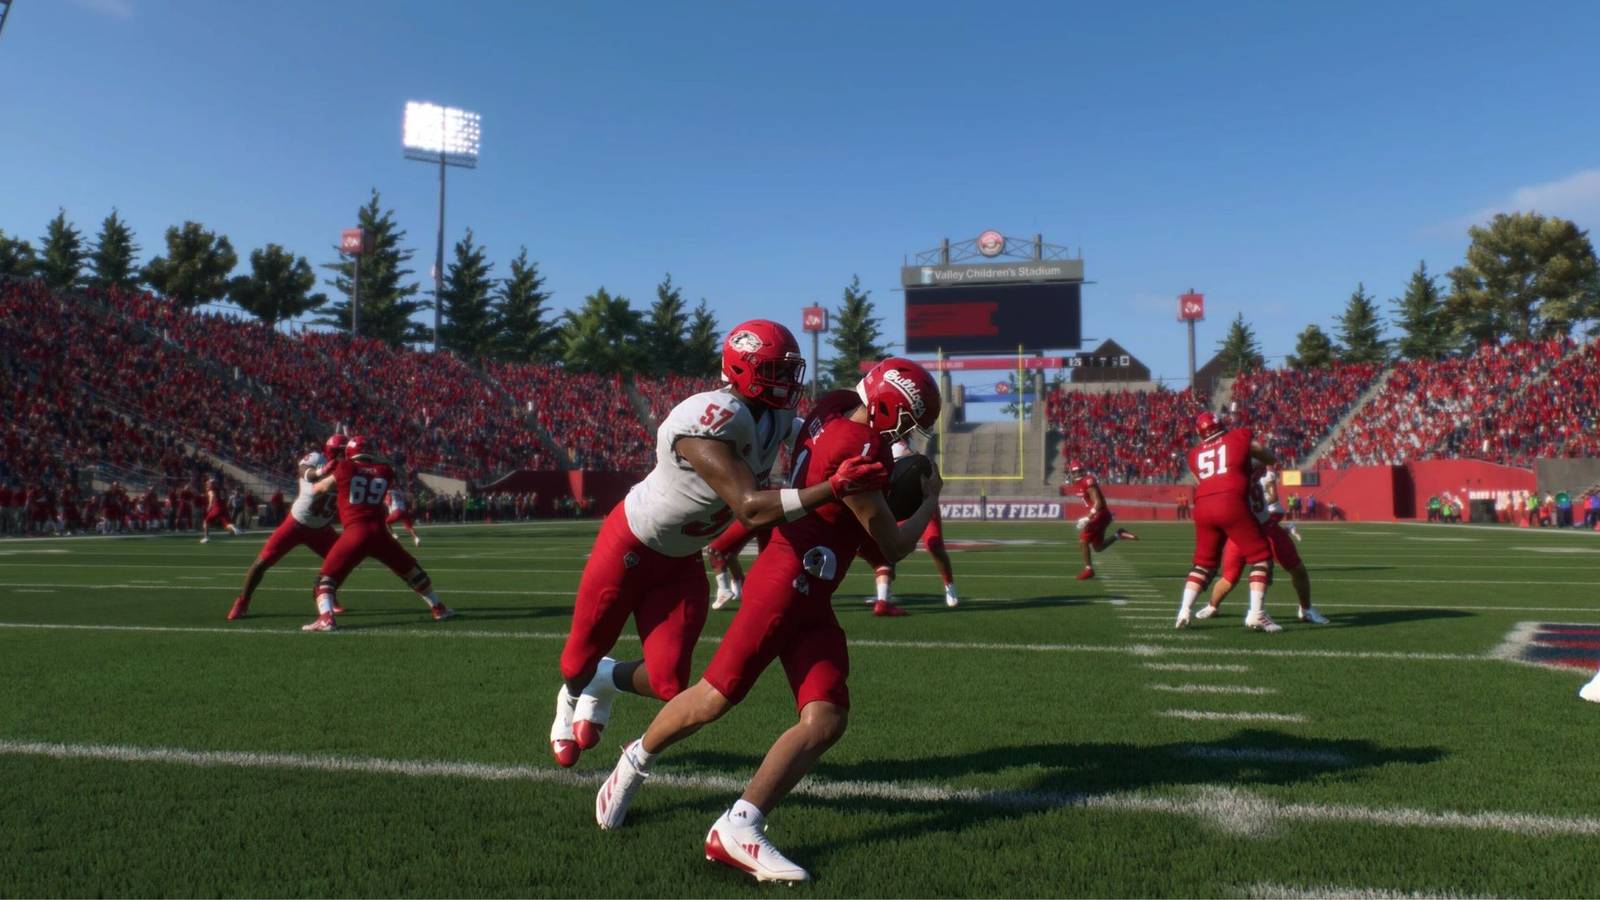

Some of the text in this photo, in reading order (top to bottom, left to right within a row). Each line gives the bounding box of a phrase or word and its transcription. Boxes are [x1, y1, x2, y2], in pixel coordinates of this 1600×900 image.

[934, 265, 1062, 281] Valley Children's Stadium
[883, 369, 926, 418] Bulldogs
[700, 402, 735, 432] 57
[1198, 444, 1228, 480] 51
[349, 475, 388, 505] 69
[938, 503, 1061, 518] WEENEY FIELD
